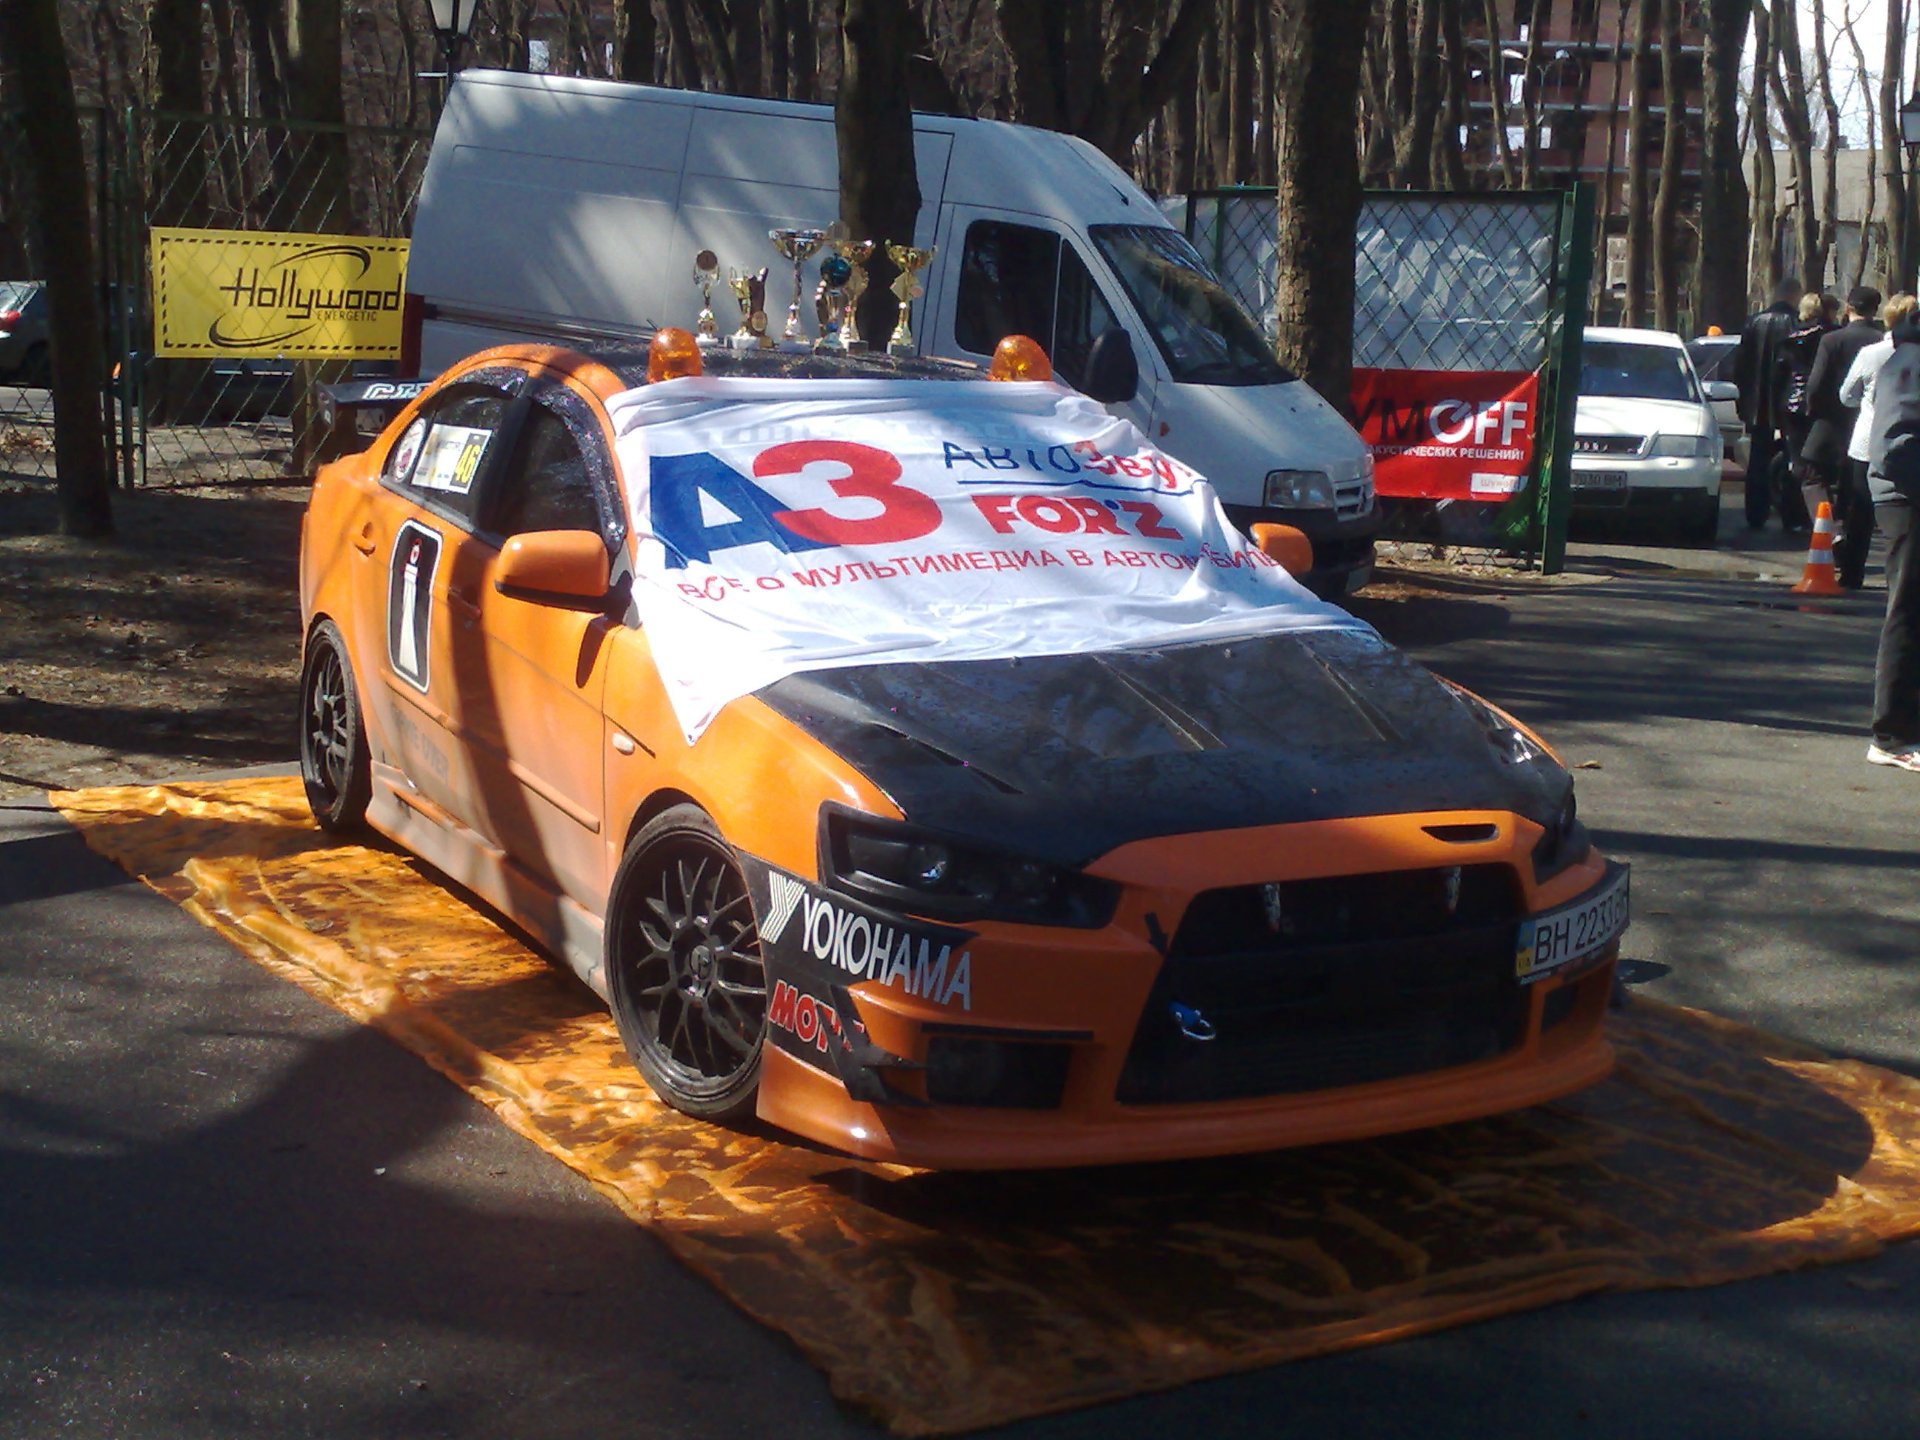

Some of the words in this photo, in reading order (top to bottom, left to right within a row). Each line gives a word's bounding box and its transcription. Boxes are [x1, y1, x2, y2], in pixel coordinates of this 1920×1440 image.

[220, 267, 402, 319] Hollywood
[317, 310, 377, 322] ENERGETIC
[455, 444, 481, 483] 46
[1460, 446, 1524, 461] РЕШЕНИЙ!
[792, 549, 1064, 588] МУЛЬТИМЕДИА
[1066, 549, 1094, 567] В
[803, 893, 971, 1011] YOKOHAMA
[1535, 918, 1570, 965] BH
[769, 978, 865, 1053] MOT
